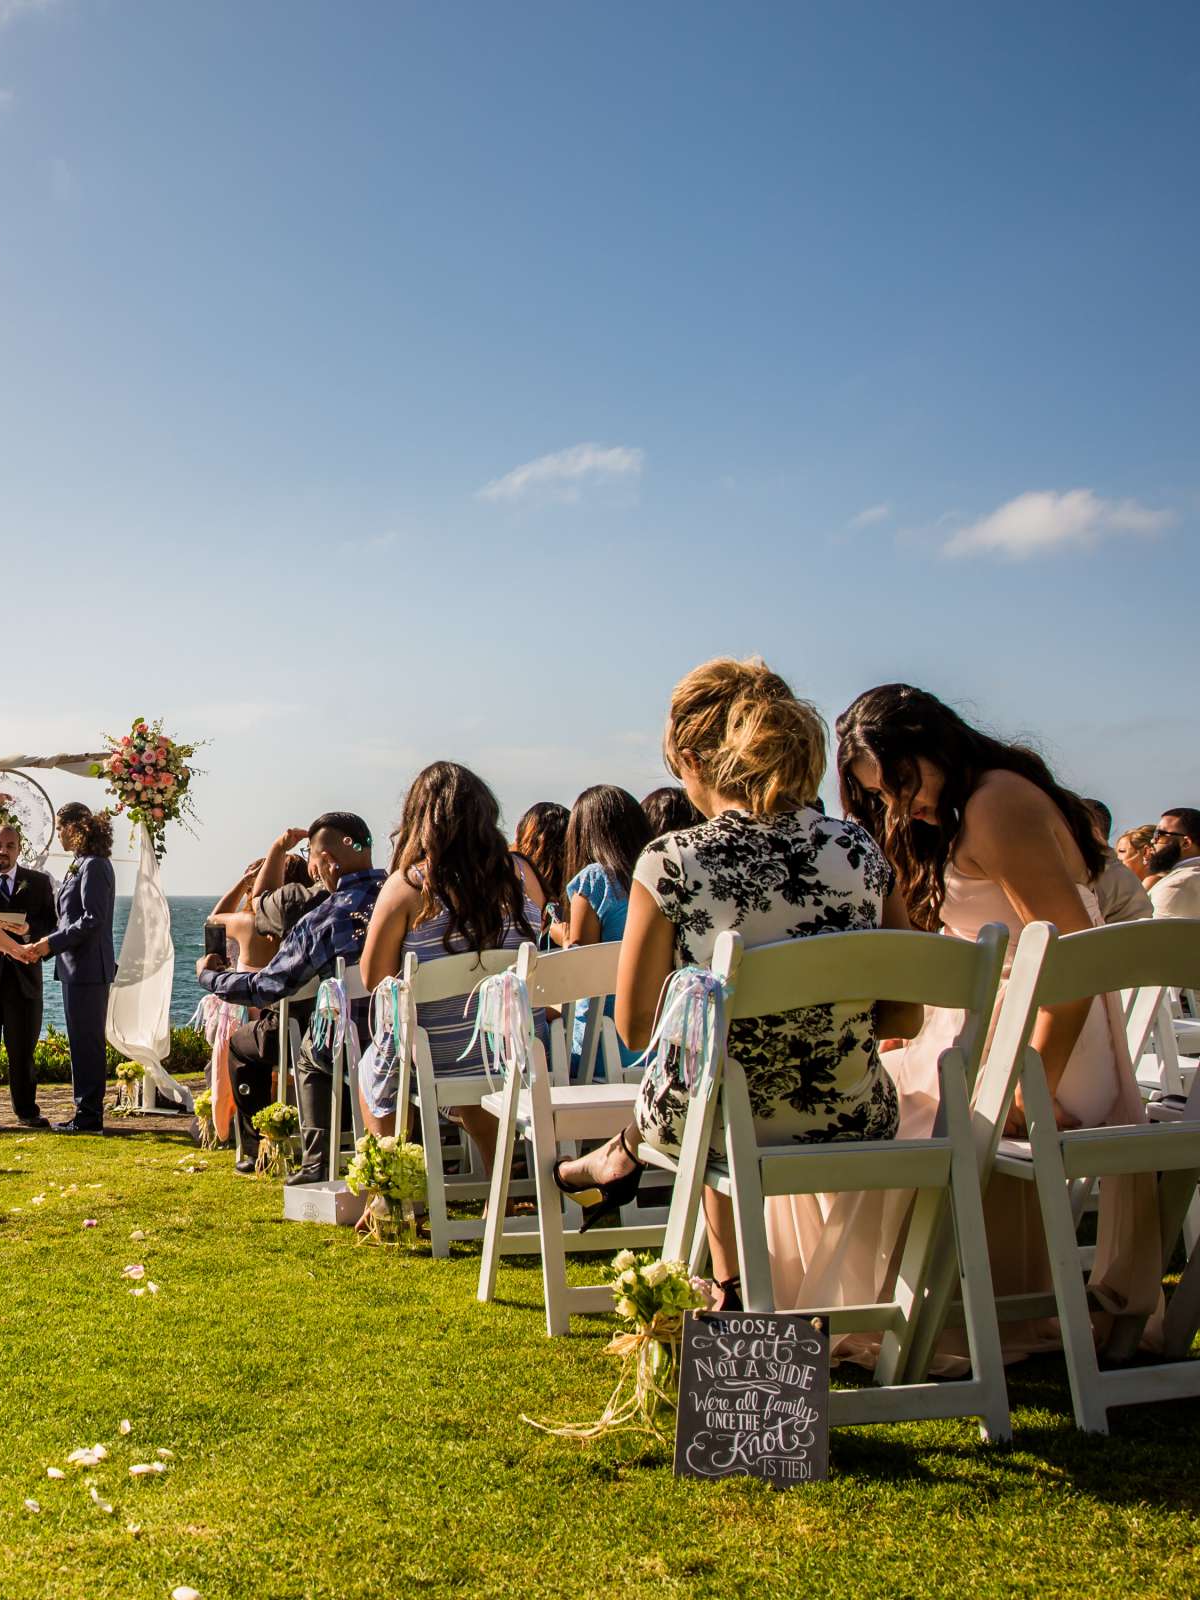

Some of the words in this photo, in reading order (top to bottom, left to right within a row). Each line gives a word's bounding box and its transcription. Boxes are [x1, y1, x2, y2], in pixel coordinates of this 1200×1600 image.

[708, 1319, 778, 1336] CHOOSE
[783, 1324, 798, 1341] A
[743, 1359, 761, 1378] A
[765, 1363, 817, 1391] SIDE
[706, 1412, 737, 1430] ONCE
[737, 1413, 761, 1431] THE
[735, 1391, 761, 1412] all
[763, 1395, 819, 1432] family
[763, 1459, 777, 1476] IS
[779, 1460, 812, 1479] TIED!
